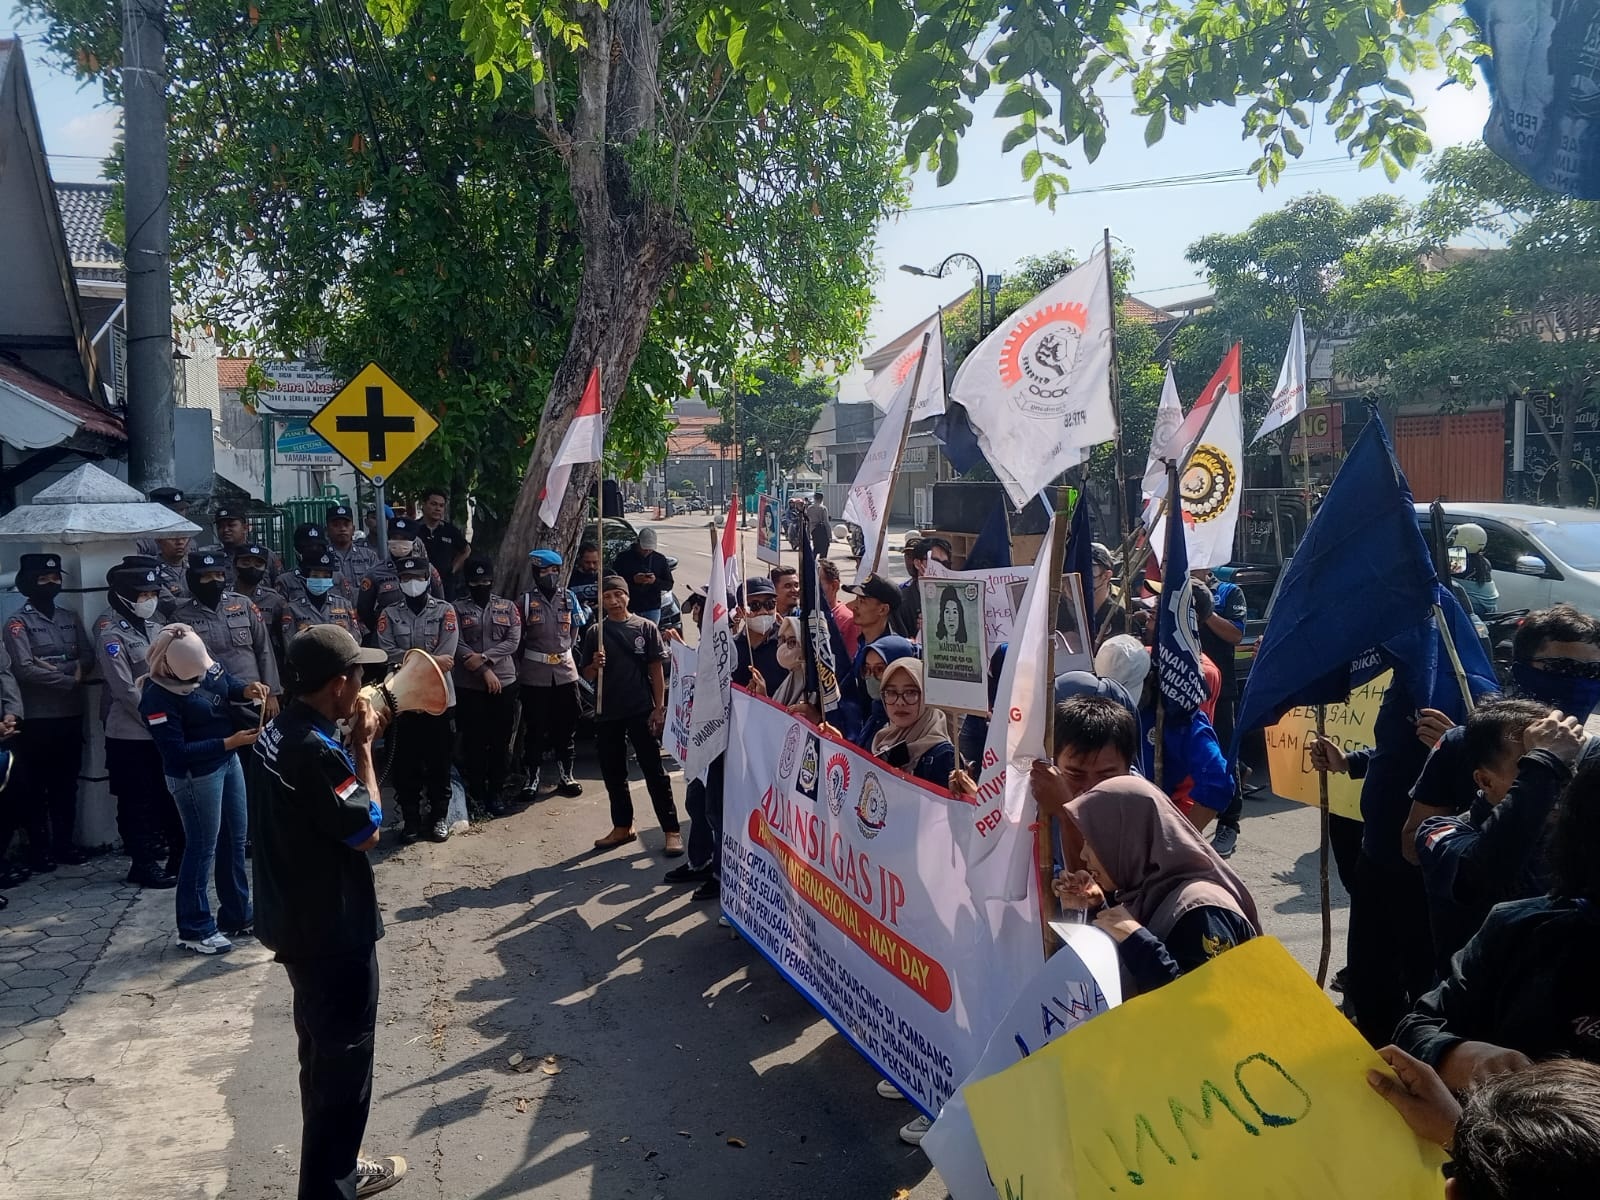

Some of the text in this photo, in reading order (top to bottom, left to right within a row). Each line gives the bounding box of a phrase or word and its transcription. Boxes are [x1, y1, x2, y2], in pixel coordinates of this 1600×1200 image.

[284, 454, 312, 462] YAMAHA
[723, 832, 738, 853] ABUT
[747, 852, 767, 877] CIPTA
[761, 784, 826, 867] ALIANSI
[831, 832, 873, 905] GAS
[879, 865, 905, 928] JP
[787, 858, 862, 938] INTERNASIONAL
[869, 924, 899, 968] MAY
[900, 949, 930, 991] DAY
[738, 884, 756, 911] TEGAS
[855, 1000, 881, 1038] UPAH
[881, 1024, 931, 1082] DIBAWAH
[740, 865, 759, 891] TEGAS
[838, 964, 884, 1018] SOURCING
[885, 1005, 896, 1029] DI
[898, 1016, 953, 1078] JOMBANG
[752, 919, 781, 954] BUSTING
[881, 1045, 927, 1101] PEKERJA
